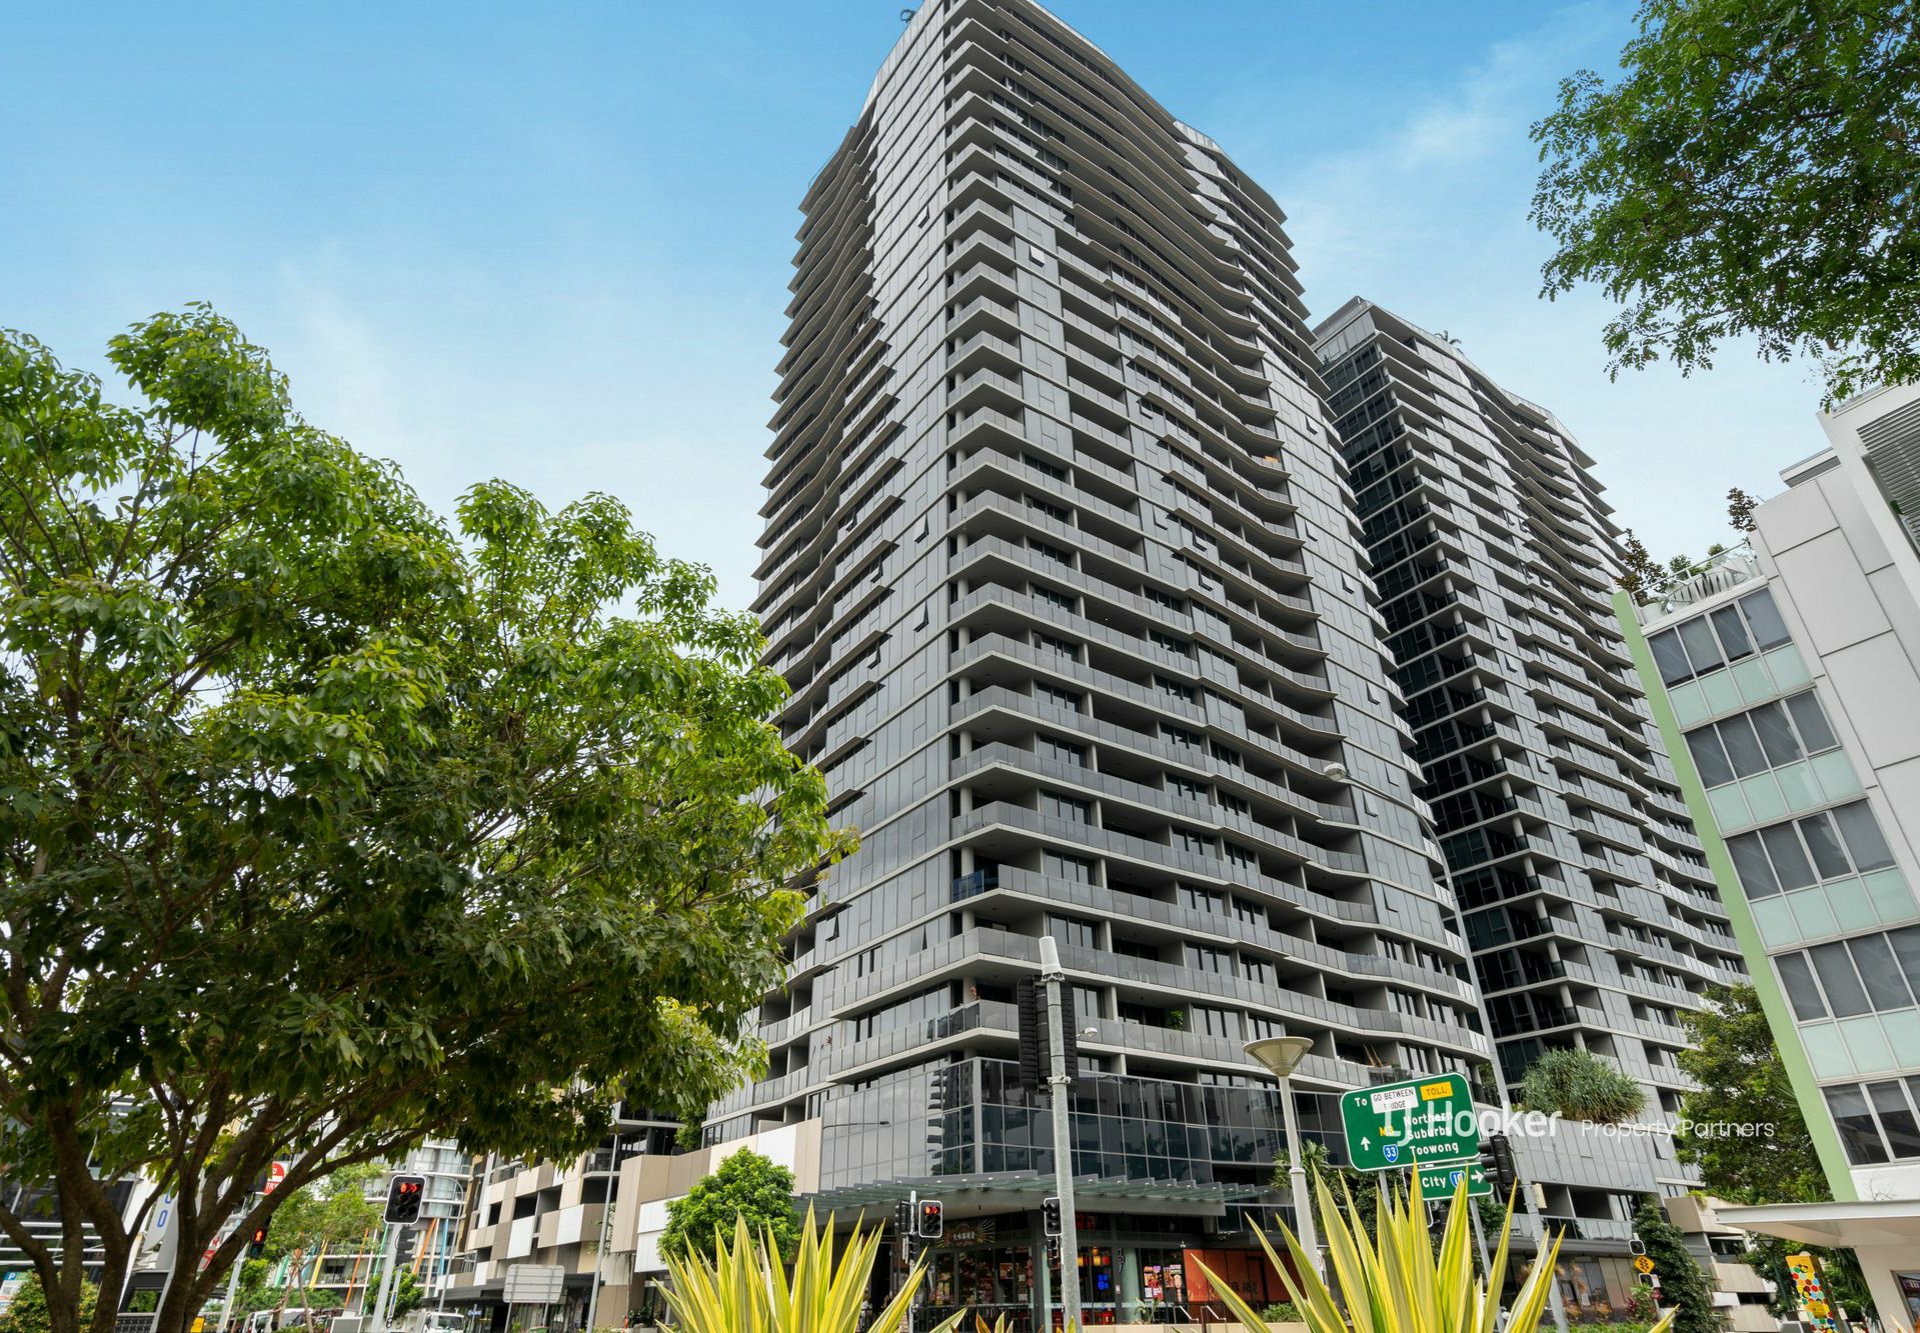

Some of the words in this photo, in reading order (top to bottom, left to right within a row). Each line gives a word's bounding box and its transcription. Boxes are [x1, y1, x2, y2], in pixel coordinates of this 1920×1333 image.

[1372, 1093, 1383, 1102] GO
[1384, 1088, 1414, 1100] BETWEEN
[1425, 1086, 1447, 1096] TOLL
[1354, 1097, 1368, 1107] To
[1403, 1112, 1453, 1126] Northern
[1407, 1126, 1451, 1140] Suburbs
[1385, 1147, 1396, 1158] 33
[1409, 1142, 1460, 1156] Toowong
[1421, 1176, 1447, 1188] City
